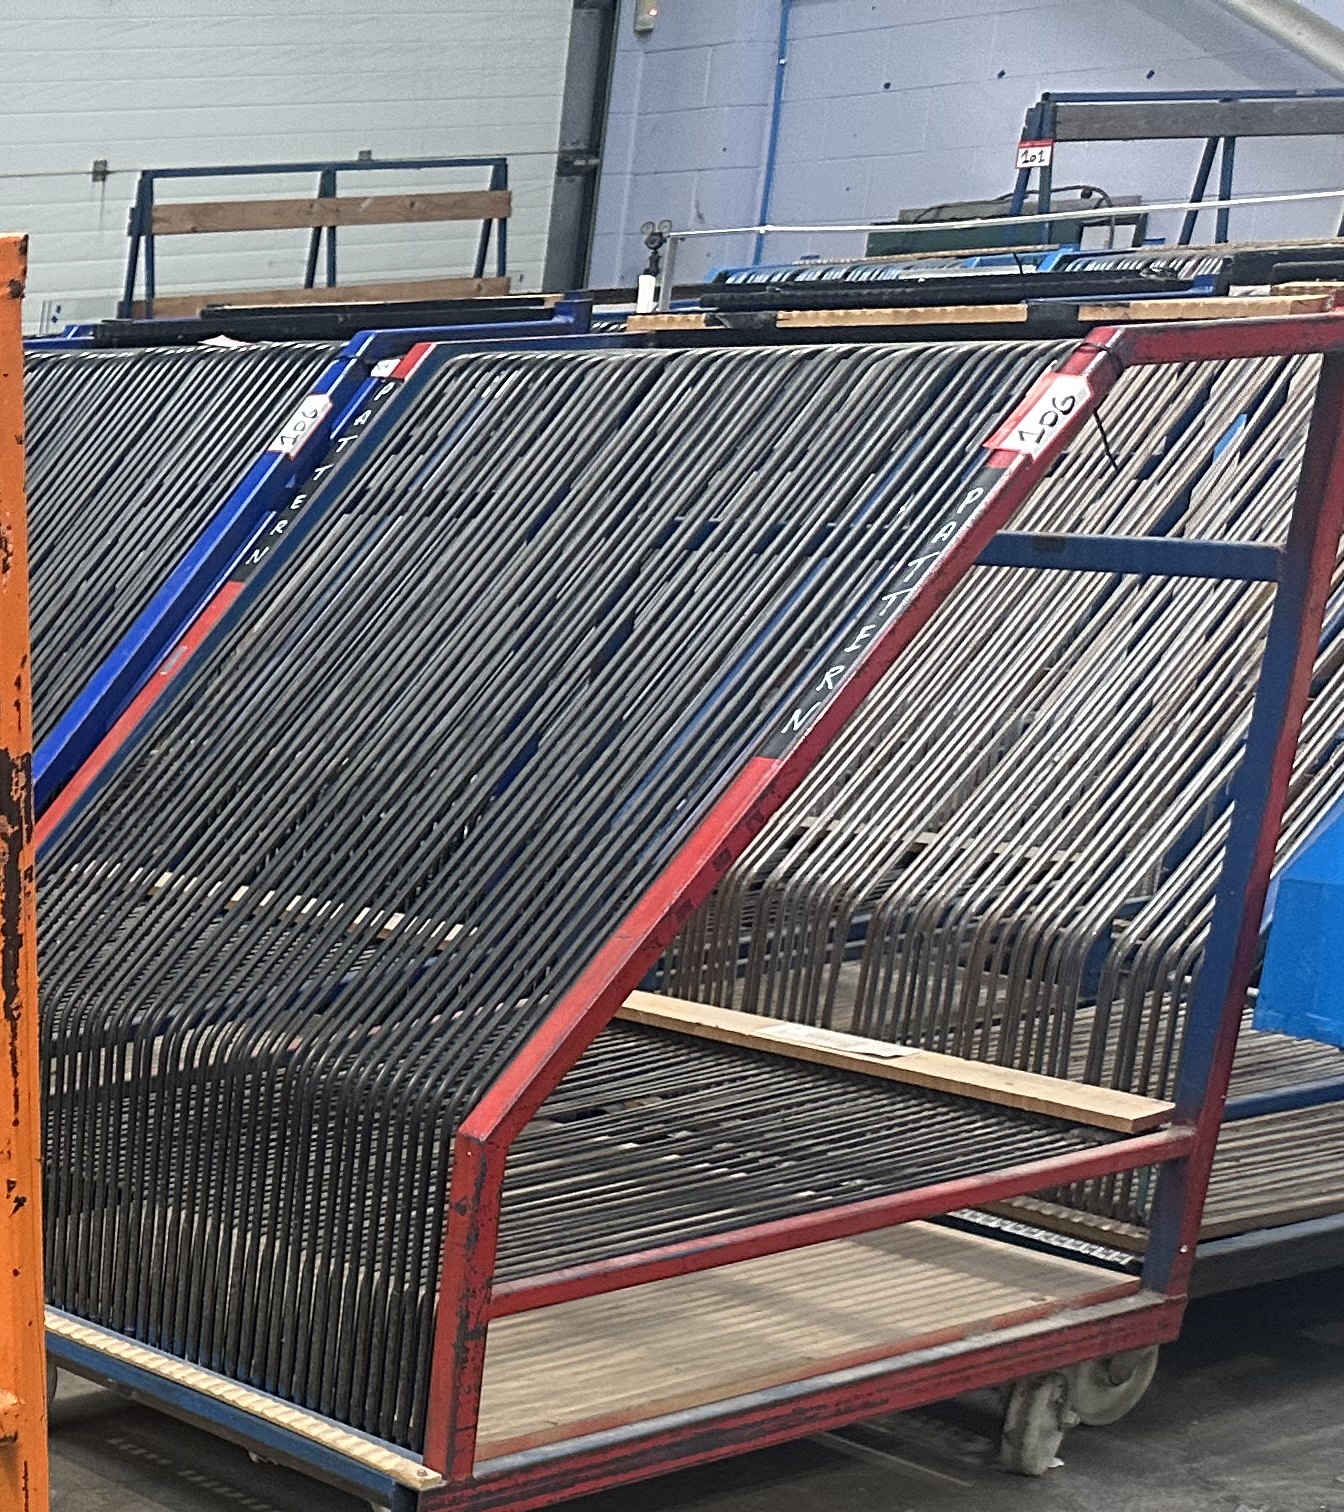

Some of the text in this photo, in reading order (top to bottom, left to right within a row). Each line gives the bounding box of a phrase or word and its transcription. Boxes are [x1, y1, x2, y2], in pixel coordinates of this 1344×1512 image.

[1021, 149, 1046, 165] 101
[280, 408, 318, 448] 106
[1018, 395, 1076, 445] 106
[245, 382, 395, 566] PATTERN
[781, 487, 984, 734] PATTERN
